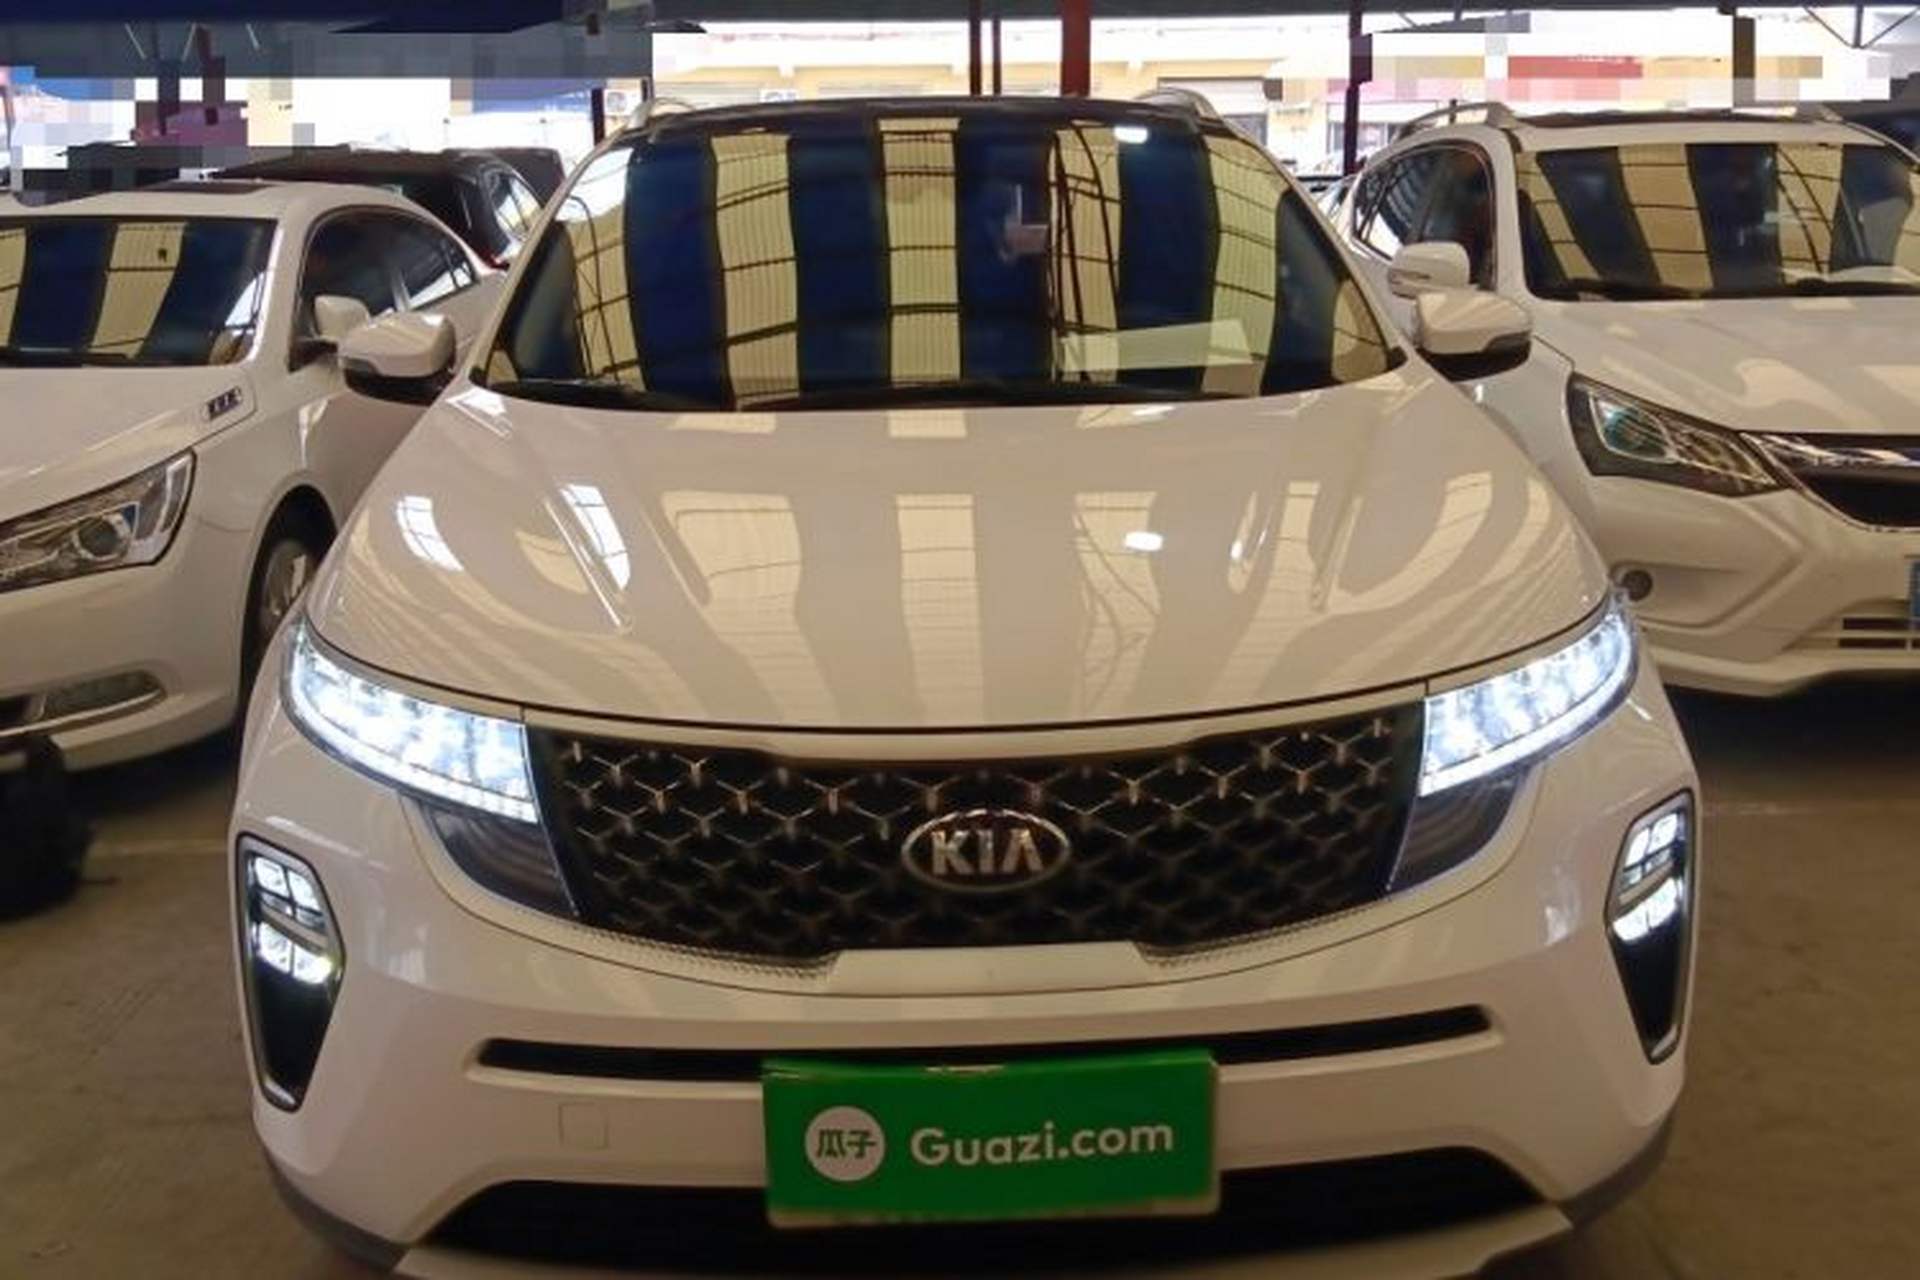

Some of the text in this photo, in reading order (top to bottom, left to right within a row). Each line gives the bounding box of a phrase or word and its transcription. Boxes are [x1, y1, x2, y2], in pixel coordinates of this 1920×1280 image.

[931, 828, 1043, 876] KIA
[816, 1128, 877, 1159] 瓜子
[910, 1121, 1174, 1166] Guazi.com
